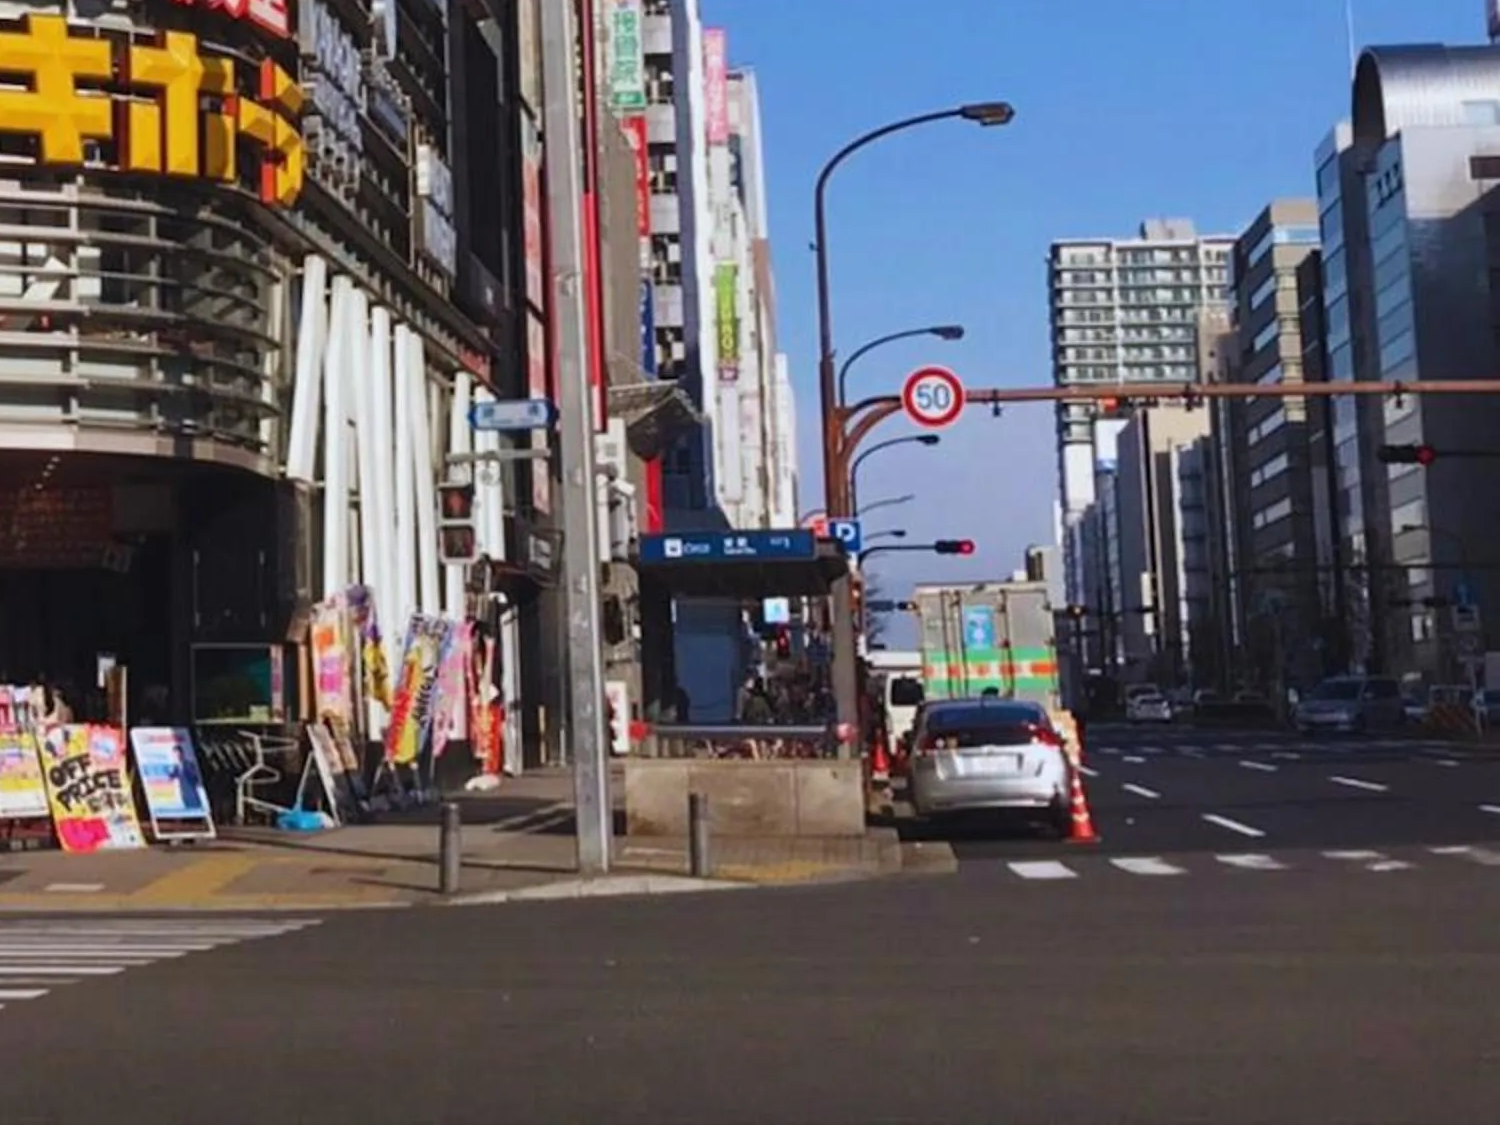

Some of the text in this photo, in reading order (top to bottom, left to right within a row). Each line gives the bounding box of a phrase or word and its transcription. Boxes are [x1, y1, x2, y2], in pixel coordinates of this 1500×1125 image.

[916, 383, 951, 411] 50
[49, 753, 92, 789] OFF
[56, 769, 123, 813] PRICE
